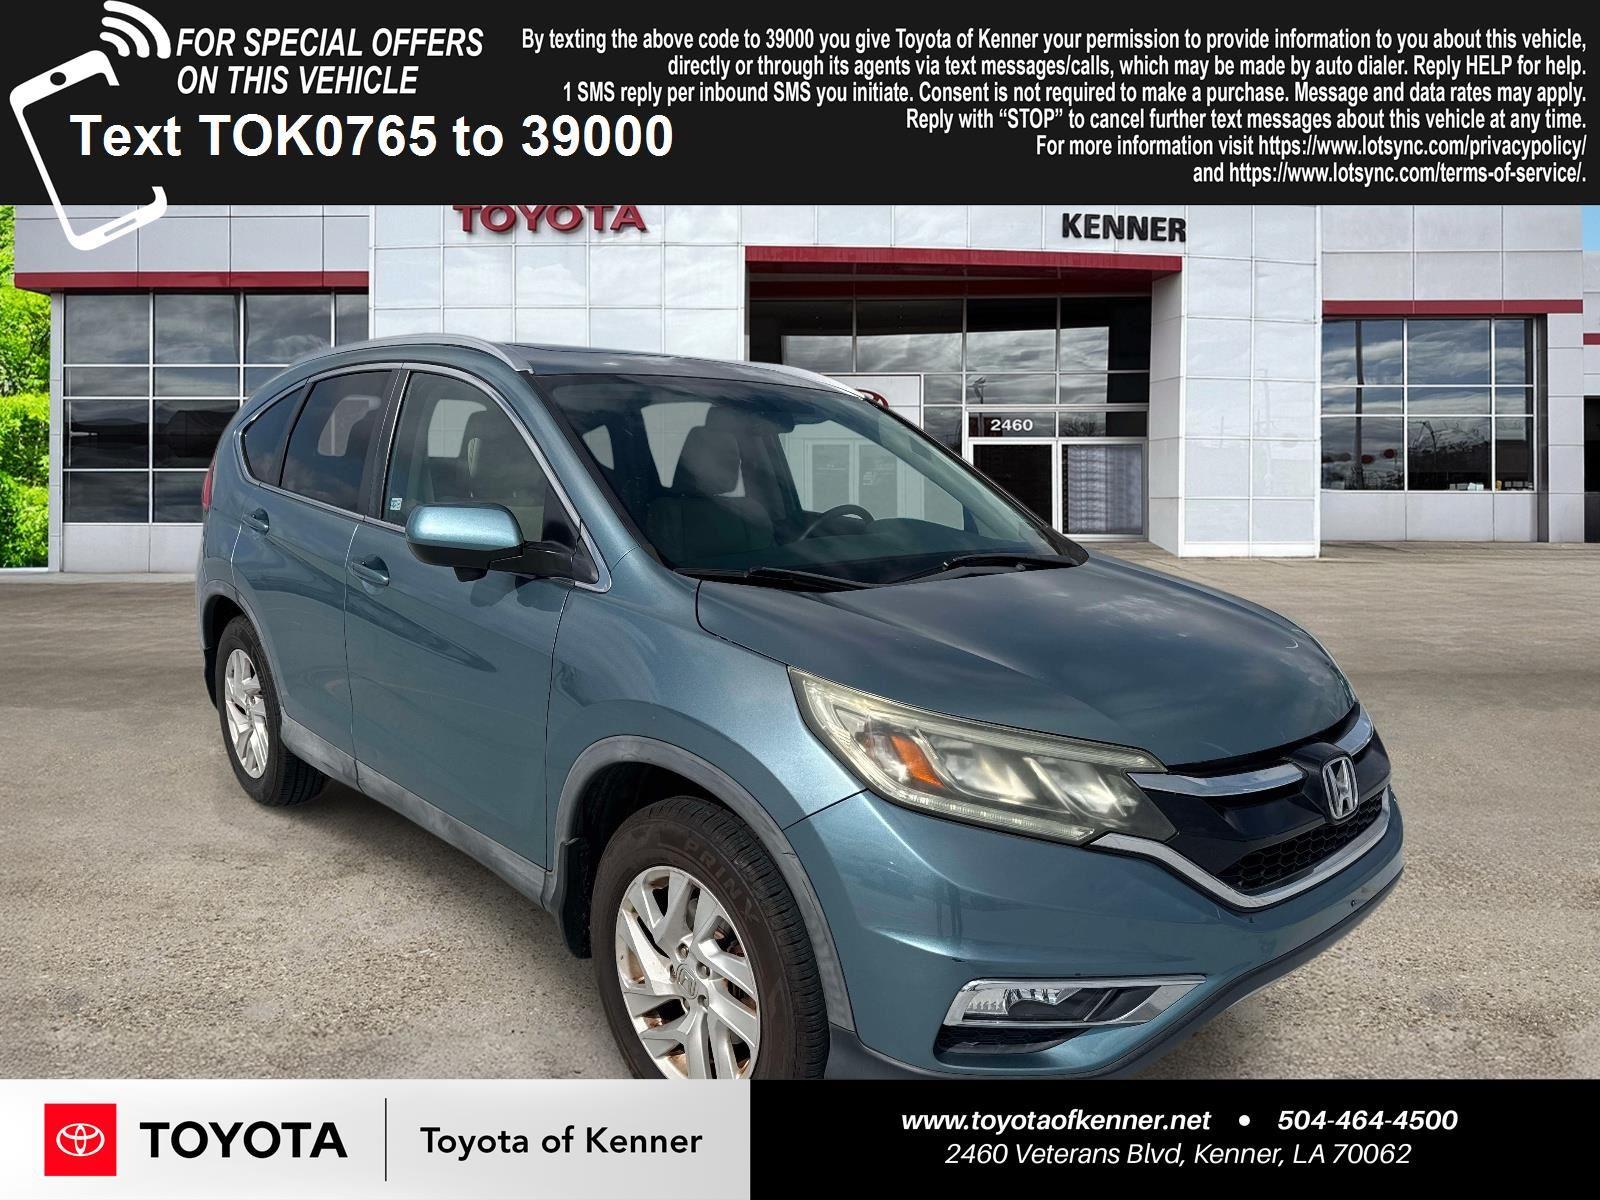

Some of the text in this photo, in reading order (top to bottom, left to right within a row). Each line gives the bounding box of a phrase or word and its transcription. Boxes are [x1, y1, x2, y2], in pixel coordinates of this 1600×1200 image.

[453, 204, 647, 232] TOYOTA
[1062, 212, 1187, 242] KENNER
[990, 419, 1033, 431] 2460
